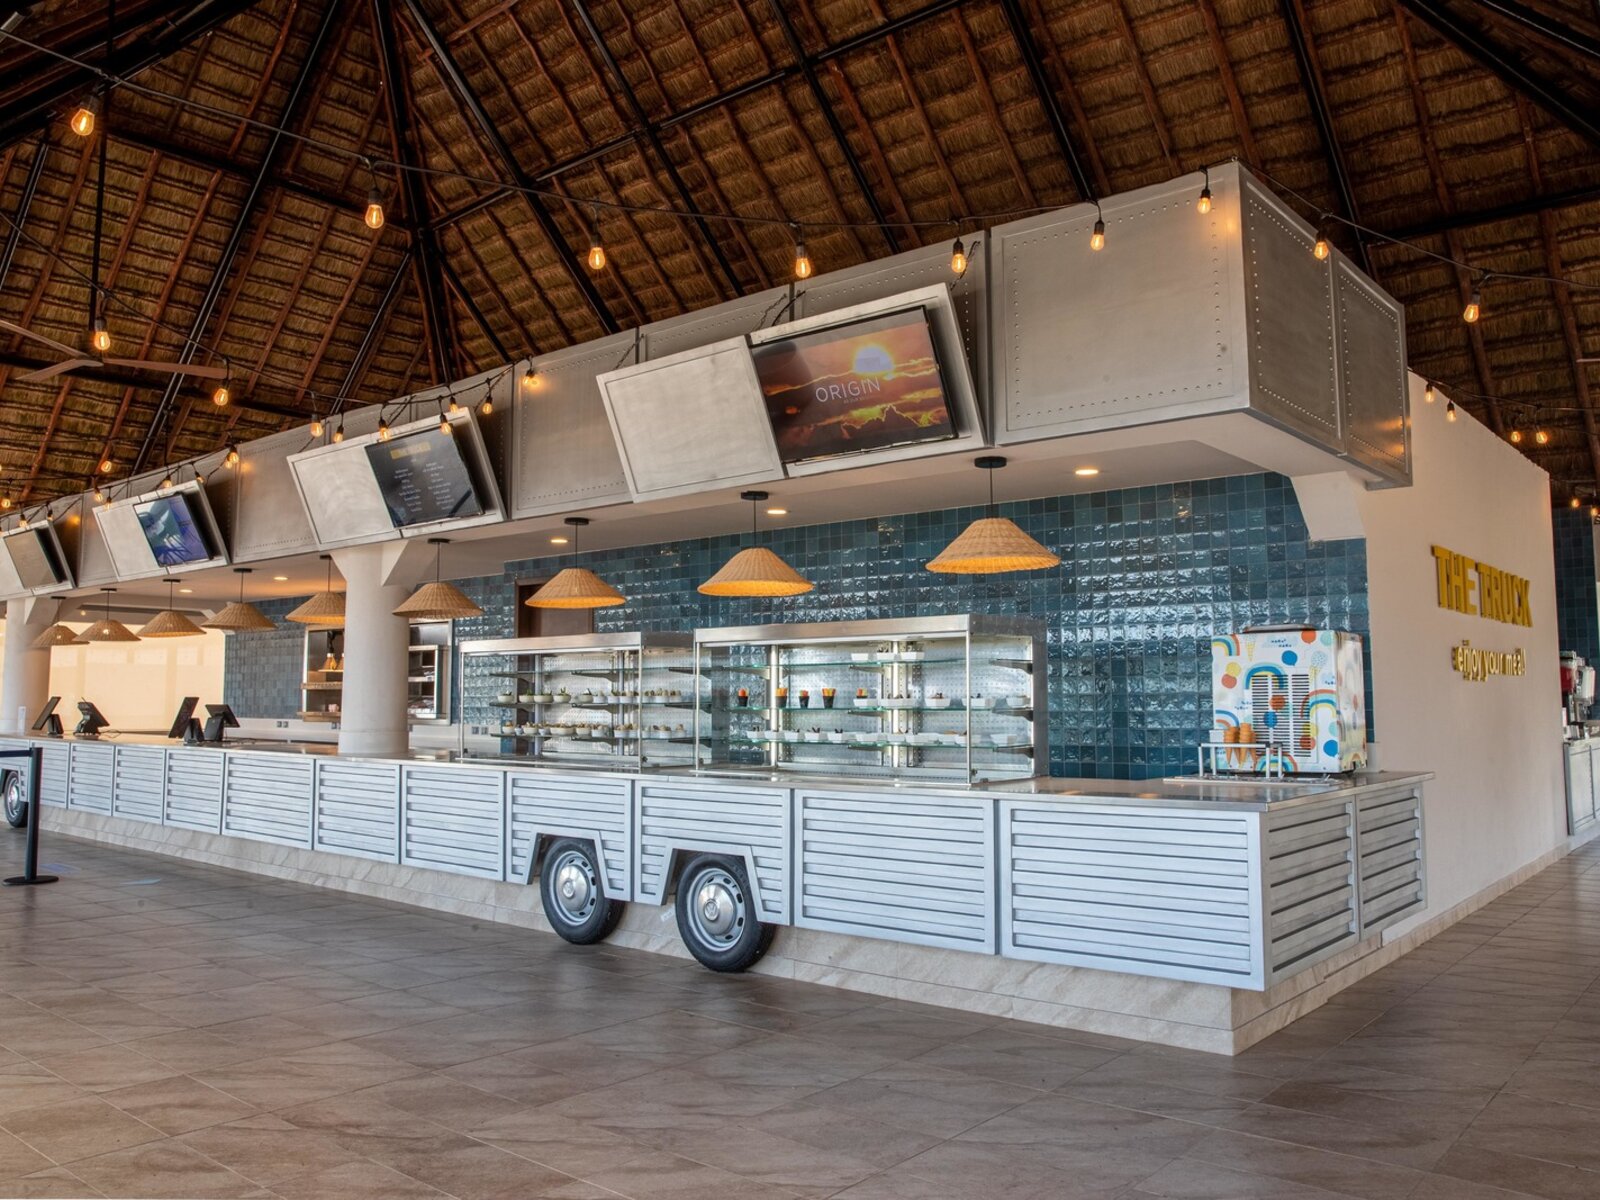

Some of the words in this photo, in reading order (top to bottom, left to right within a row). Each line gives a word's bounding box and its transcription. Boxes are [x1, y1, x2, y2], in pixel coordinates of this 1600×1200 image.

[815, 376, 881, 403] ORIGIN
[1430, 545, 1477, 616] THE
[1475, 562, 1533, 628] TRUCK
[1451, 639, 1482, 682] enjoy
[1480, 650, 1504, 682] your
